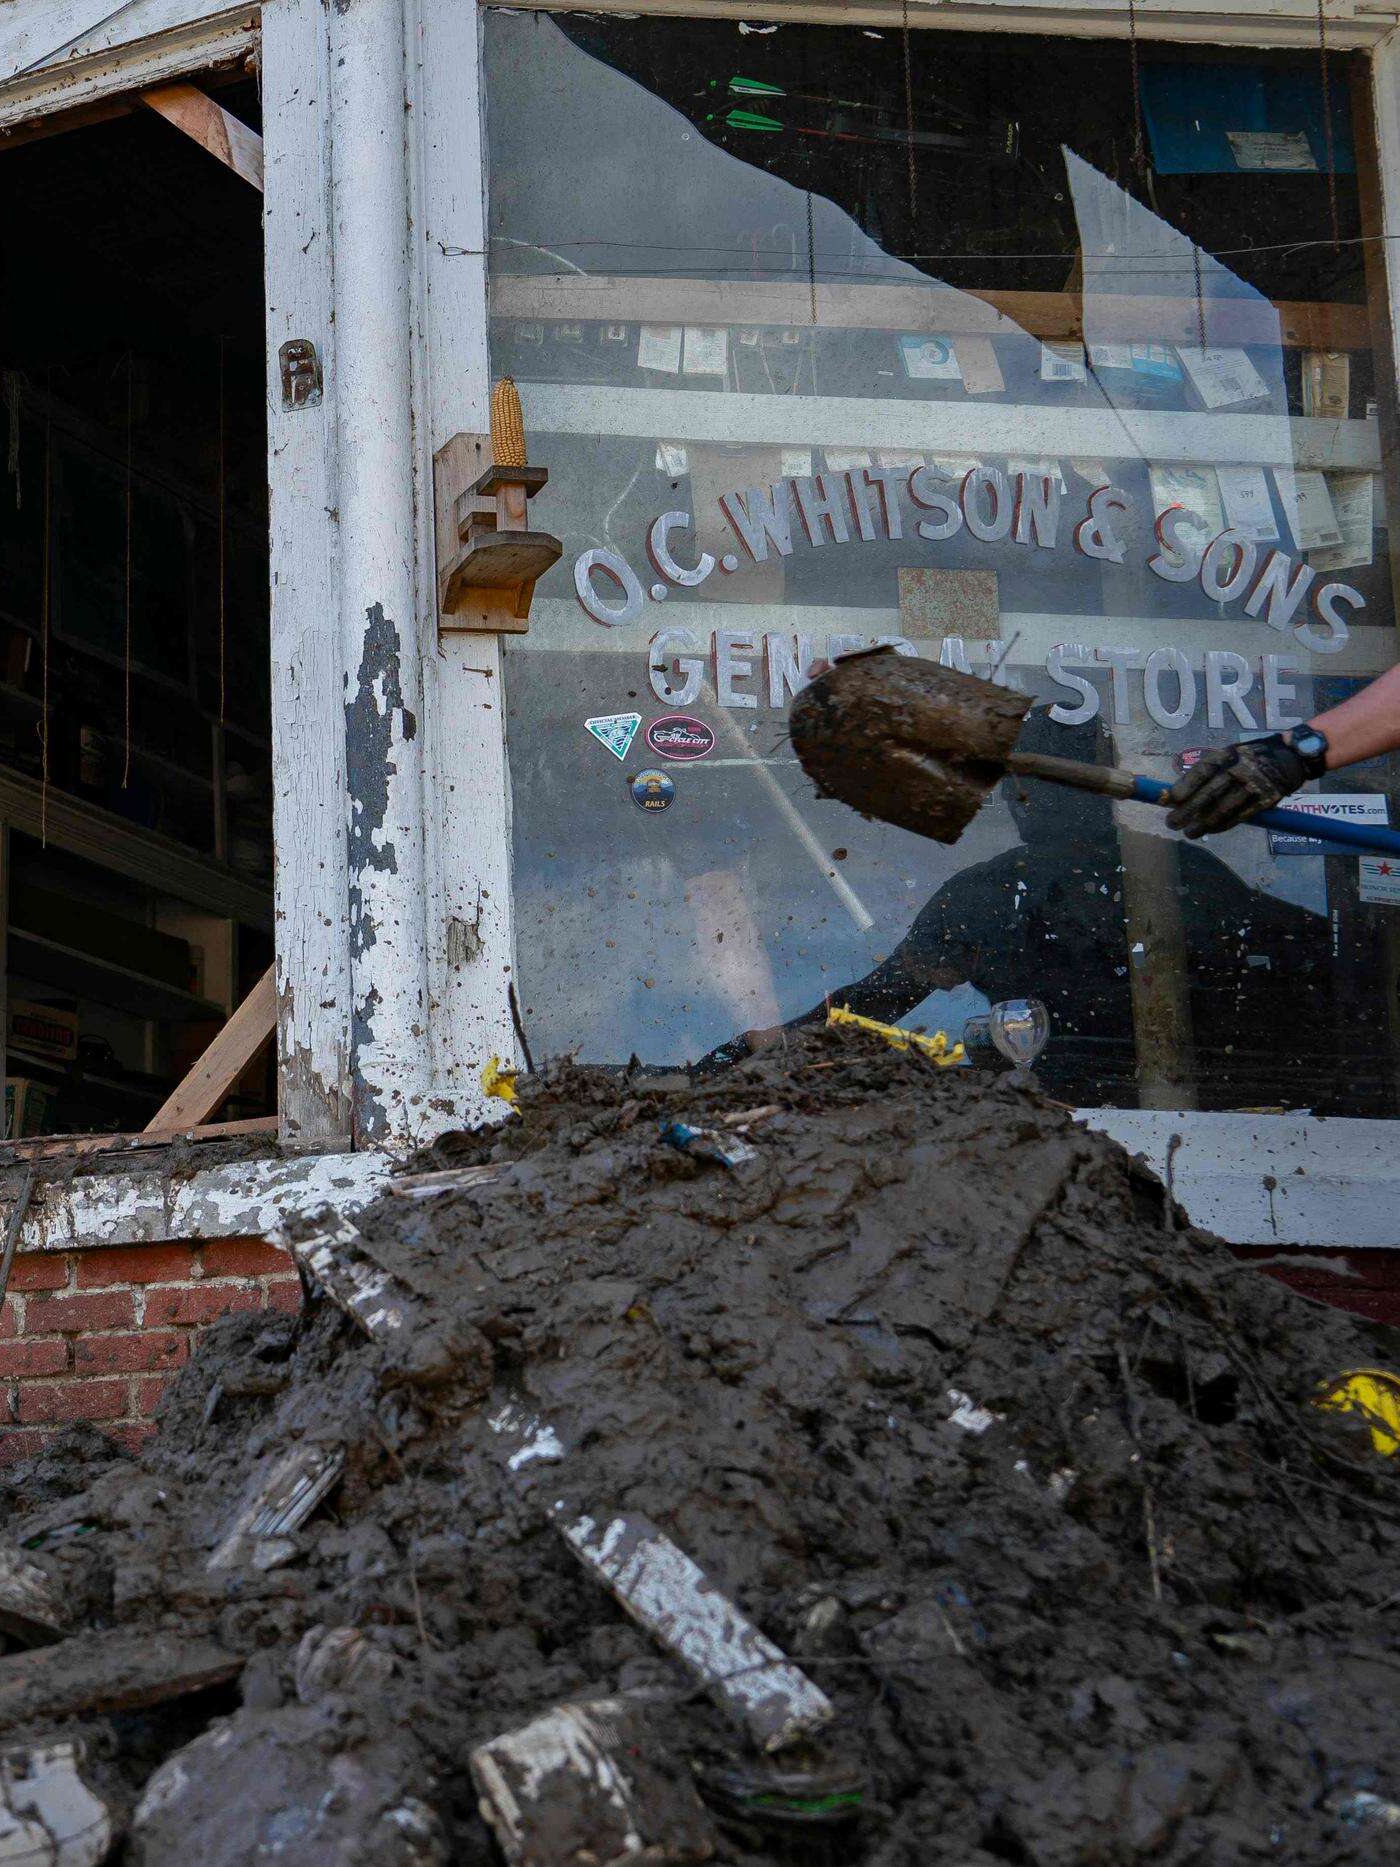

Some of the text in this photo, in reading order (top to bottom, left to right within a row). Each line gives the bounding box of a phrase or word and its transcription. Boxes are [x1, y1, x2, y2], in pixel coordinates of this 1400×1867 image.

[718, 465, 1063, 562] WHITSON
[1072, 485, 1136, 564] &
[1149, 502, 1367, 654] SONS
[1047, 642, 1303, 731] STORE
[645, 800, 666, 808] RAILS
[1271, 833, 1308, 844] Because
